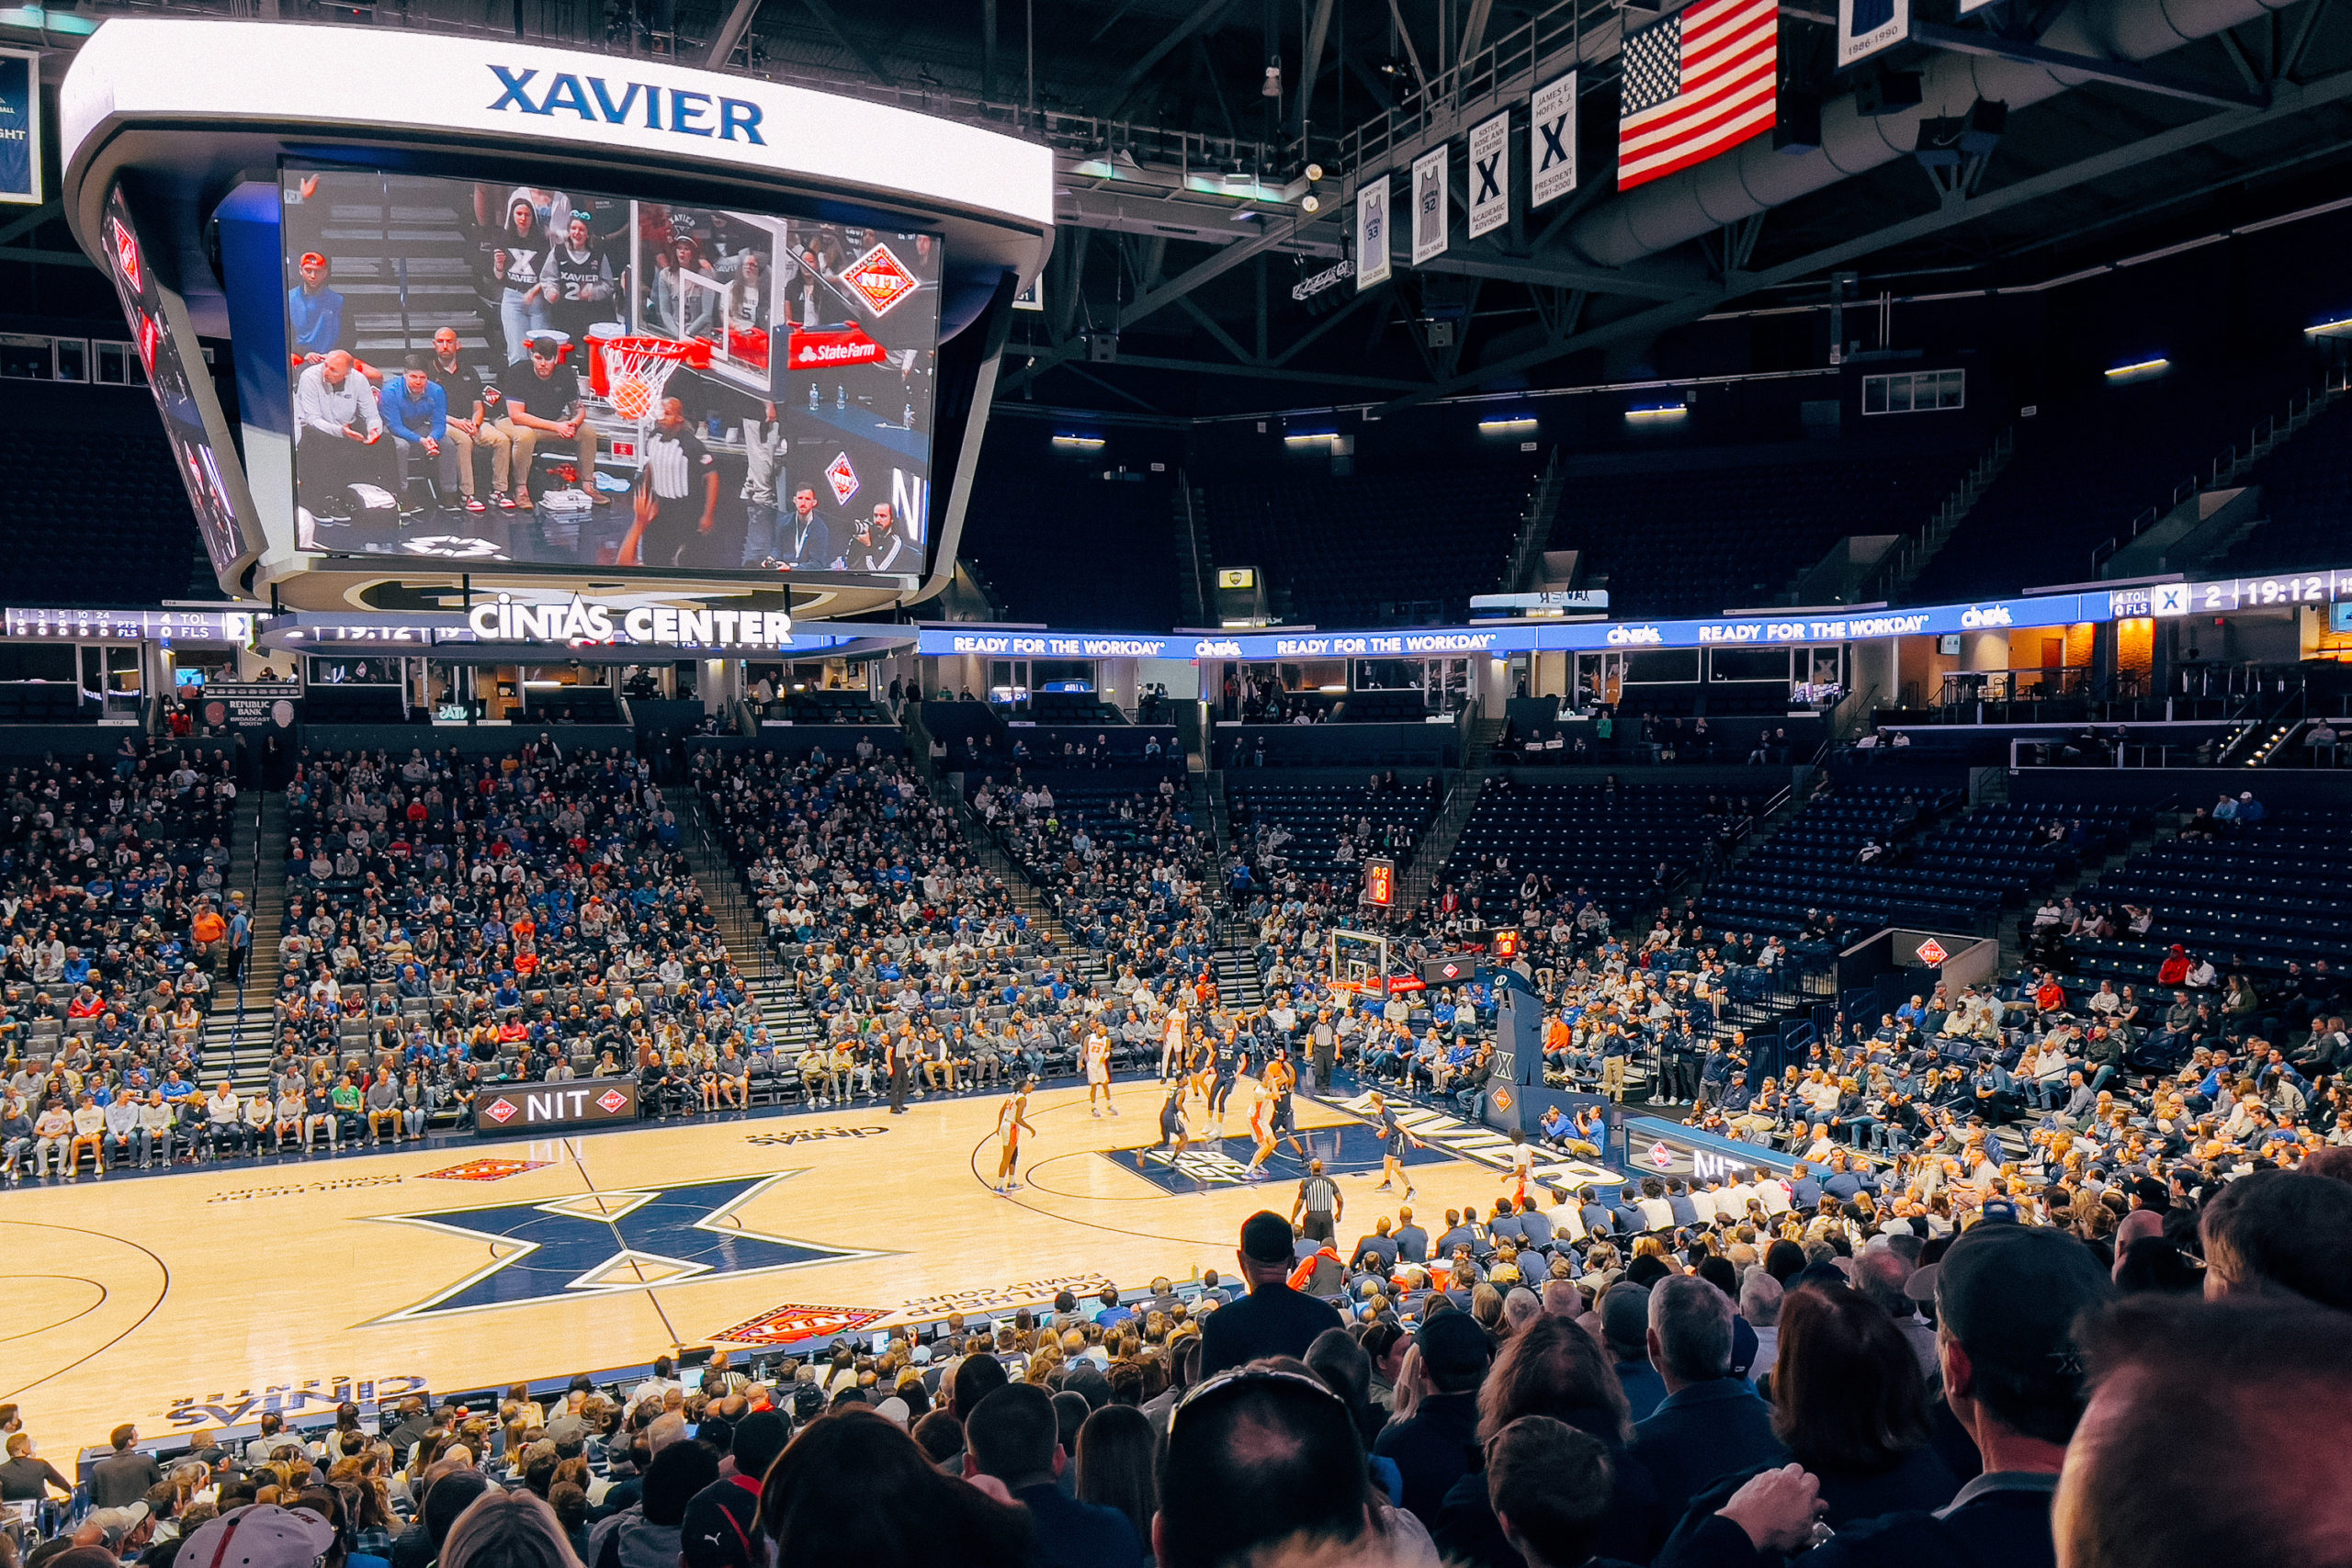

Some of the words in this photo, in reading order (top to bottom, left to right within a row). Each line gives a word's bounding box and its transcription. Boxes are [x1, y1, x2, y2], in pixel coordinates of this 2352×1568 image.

[1848, 25, 1898, 56] 1986-1990
[485, 63, 769, 147] XAVIER
[1537, 88, 1562, 107] JAMES
[1474, 134, 1491, 150] ROSE
[1490, 127, 1505, 141] ANN
[1478, 120, 1500, 138] SISTER
[1476, 138, 1503, 157] FLEMING
[1538, 110, 1569, 175] X
[1475, 149, 1502, 207] X
[1534, 166, 1574, 192] PRESIDENT
[1538, 178, 1572, 201] 1991-2000
[1423, 197, 1436, 215] 32
[1472, 201, 1506, 223] ACADEMIC
[1474, 212, 1503, 231] ADVISOR
[1367, 225, 1379, 242] 33
[560, 271, 599, 282] XAVIER
[860, 272, 903, 290] NIT
[2115, 592, 2123, 603] 4
[2126, 591, 2148, 602] TOL
[2162, 590, 2179, 610] X
[2206, 585, 2222, 608] 2
[2247, 576, 2324, 605] 19:12
[77, 611, 88, 619] 10
[96, 612, 110, 620] 24
[160, 613, 172, 625] 4
[180, 614, 209, 626] TOL
[2115, 604, 2124, 616] 0
[2126, 604, 2149, 615] FLS
[118, 620, 137, 629] PTS
[118, 628, 138, 637] FLS
[161, 626, 173, 638] 0
[183, 626, 209, 638] FLS
[624, 606, 794, 645] CENTER
[1698, 625, 1762, 642] READY
[1766, 623, 1805, 640] FOR
[1811, 620, 1847, 637] THE
[954, 636, 1010, 652] READY
[1013, 637, 1046, 653] FOR
[1049, 639, 1080, 655] THE
[1276, 639, 1329, 655] READY
[1333, 637, 1368, 653] FOR
[1371, 637, 1402, 652] THE
[229, 700, 271, 708] REPUBLIC
[1376, 879, 1386, 900] 18
[1502, 941, 1511, 953] 18
[1091, 1045, 1101, 1054] 23
[527, 1089, 590, 1122] NIT
[1473, 1228, 1487, 1240] 11
[1004, 1272, 1103, 1293] FAMILY
[902, 1288, 998, 1308] COURT
[757, 1314, 851, 1337] NIT
[171, 1376, 351, 1407] CENTER
